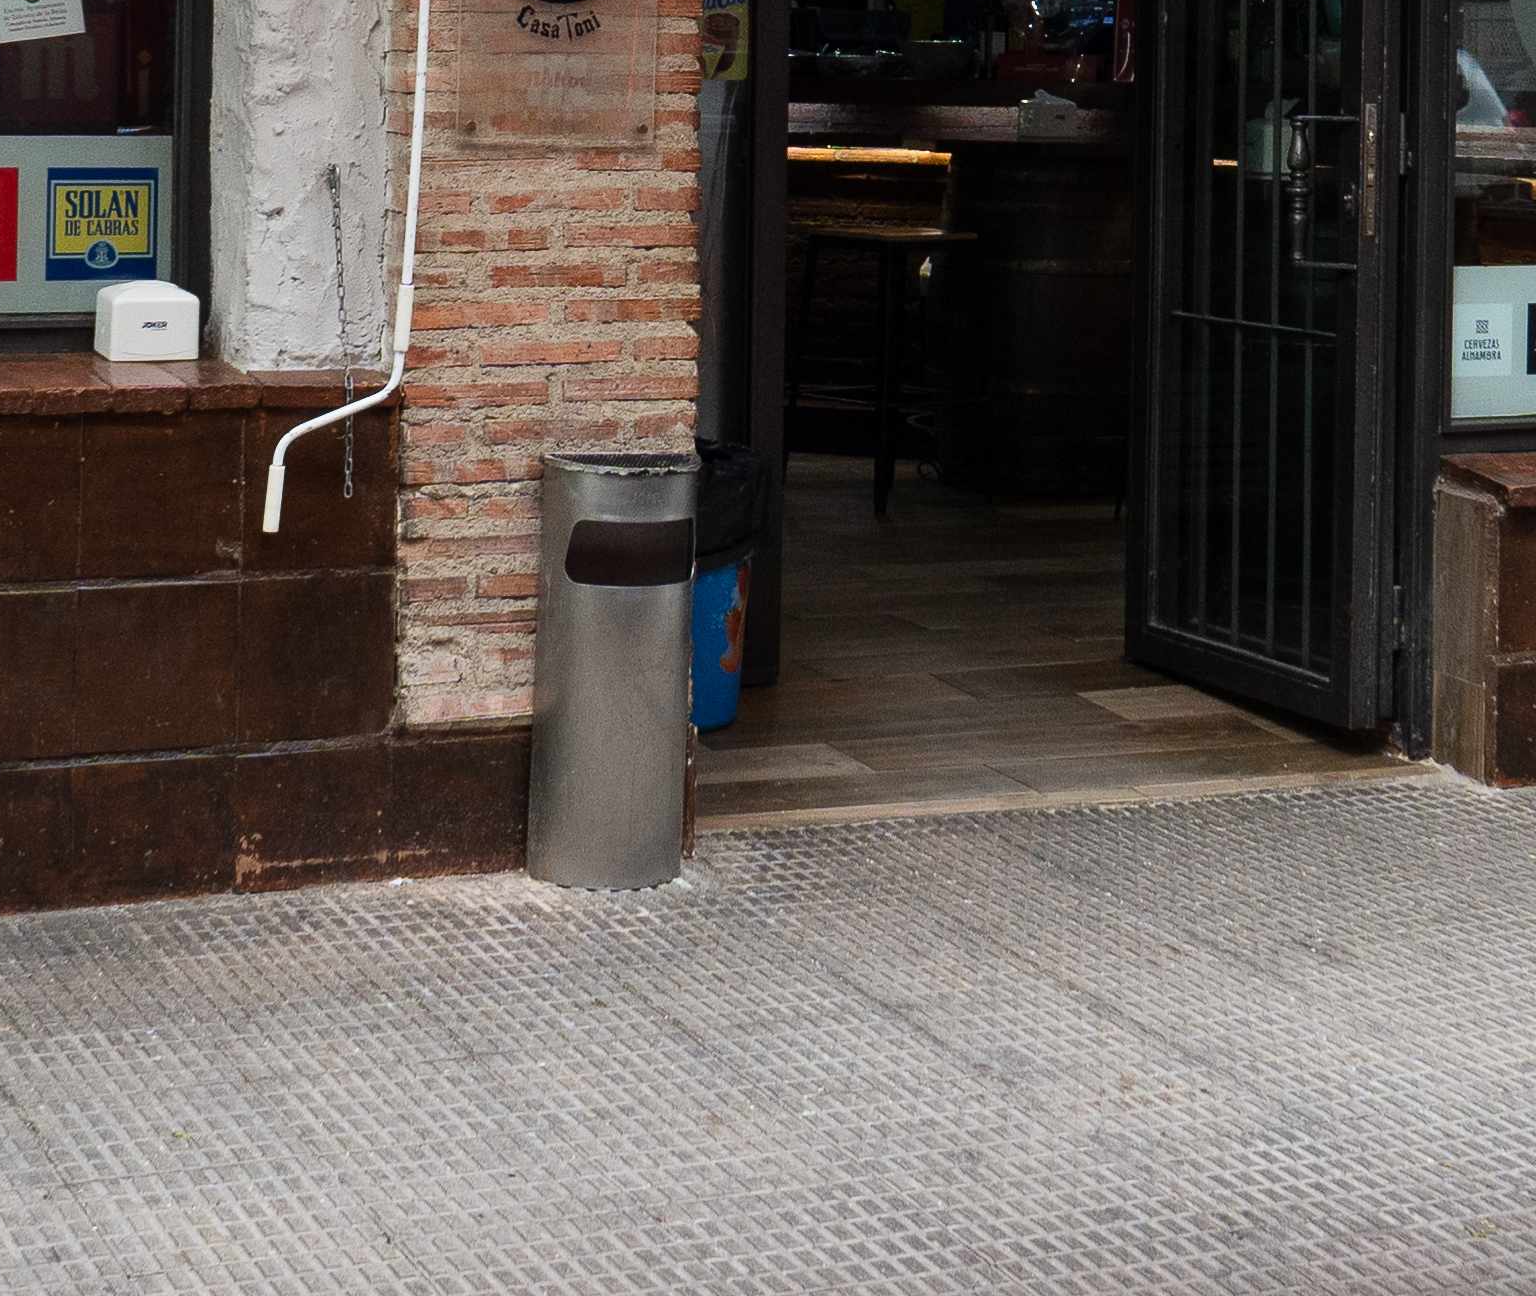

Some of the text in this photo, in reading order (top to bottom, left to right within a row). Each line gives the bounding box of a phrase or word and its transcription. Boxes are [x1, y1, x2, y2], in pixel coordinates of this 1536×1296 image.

[516, 4, 602, 42] Casa Toni
[65, 219, 140, 237] DE CABRAS
[1461, 350, 1502, 361] ALHAMBRA
